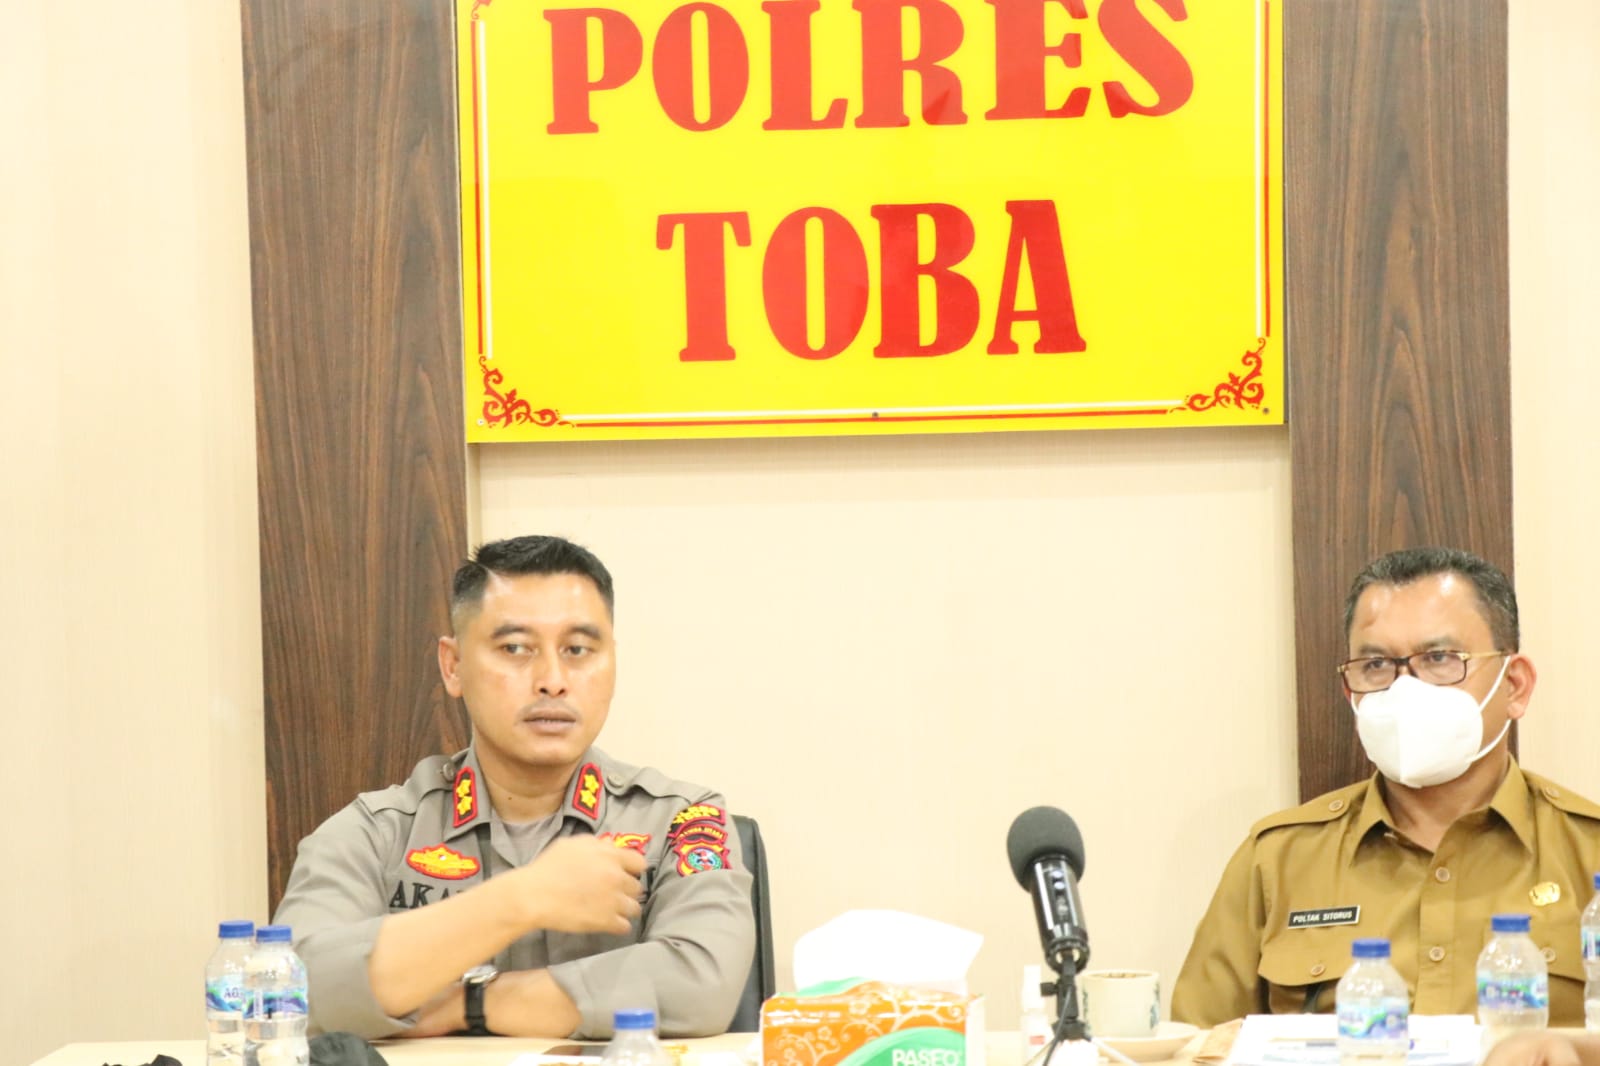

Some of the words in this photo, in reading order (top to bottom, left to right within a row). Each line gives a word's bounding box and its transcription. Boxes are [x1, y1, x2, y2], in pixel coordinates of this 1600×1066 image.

[544, 0, 1193, 134] POLRES
[656, 200, 1087, 362] TOBA
[1322, 911, 1353, 921] SITORUS
[892, 1049, 959, 1066] PASEO
